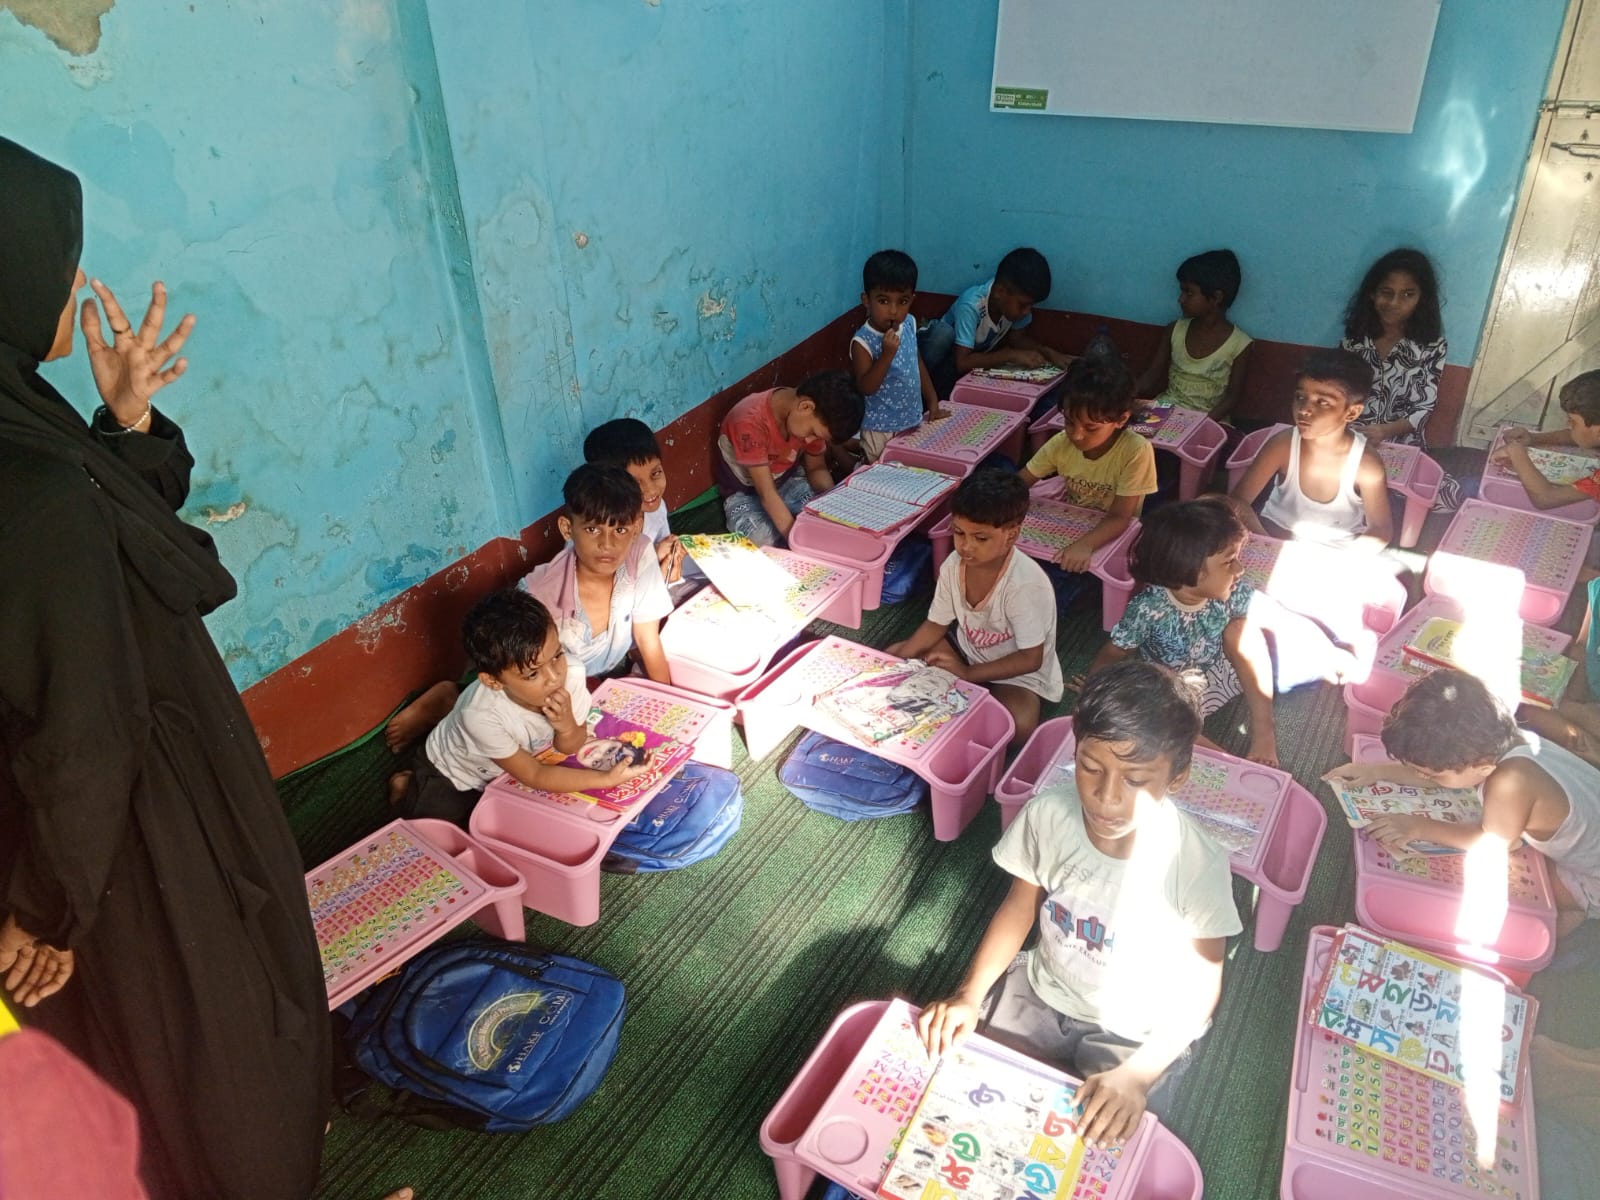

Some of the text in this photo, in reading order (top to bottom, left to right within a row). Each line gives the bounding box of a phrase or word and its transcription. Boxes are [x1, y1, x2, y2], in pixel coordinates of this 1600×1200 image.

[1344, 969, 1385, 1039] শ ষ
[1409, 988, 1437, 1012] ড়
[1318, 1003, 1345, 1028] র
[1369, 979, 1412, 1053] স হ
[873, 1060, 888, 1073] M
[1425, 1048, 1455, 1075] ঢ়
[1351, 1056, 1365, 1147] ১ ২ ৩ ৪ ৫ ৬
[1367, 1062, 1381, 1153] 1 2 3 4 5 6
[1433, 1097, 1445, 1107] E
[1449, 1102, 1460, 1112] R
[968, 1083, 1077, 1137] এ ঐ
[1434, 1112, 1445, 1123] D
[1449, 1117, 1461, 1128] Q
[1434, 1128, 1445, 1140] C
[1450, 1135, 1461, 1145] P
[1433, 1148, 1445, 1159] B
[1451, 1152, 1463, 1164] O
[1433, 1165, 1445, 1177] A
[1450, 1171, 1463, 1184] N
